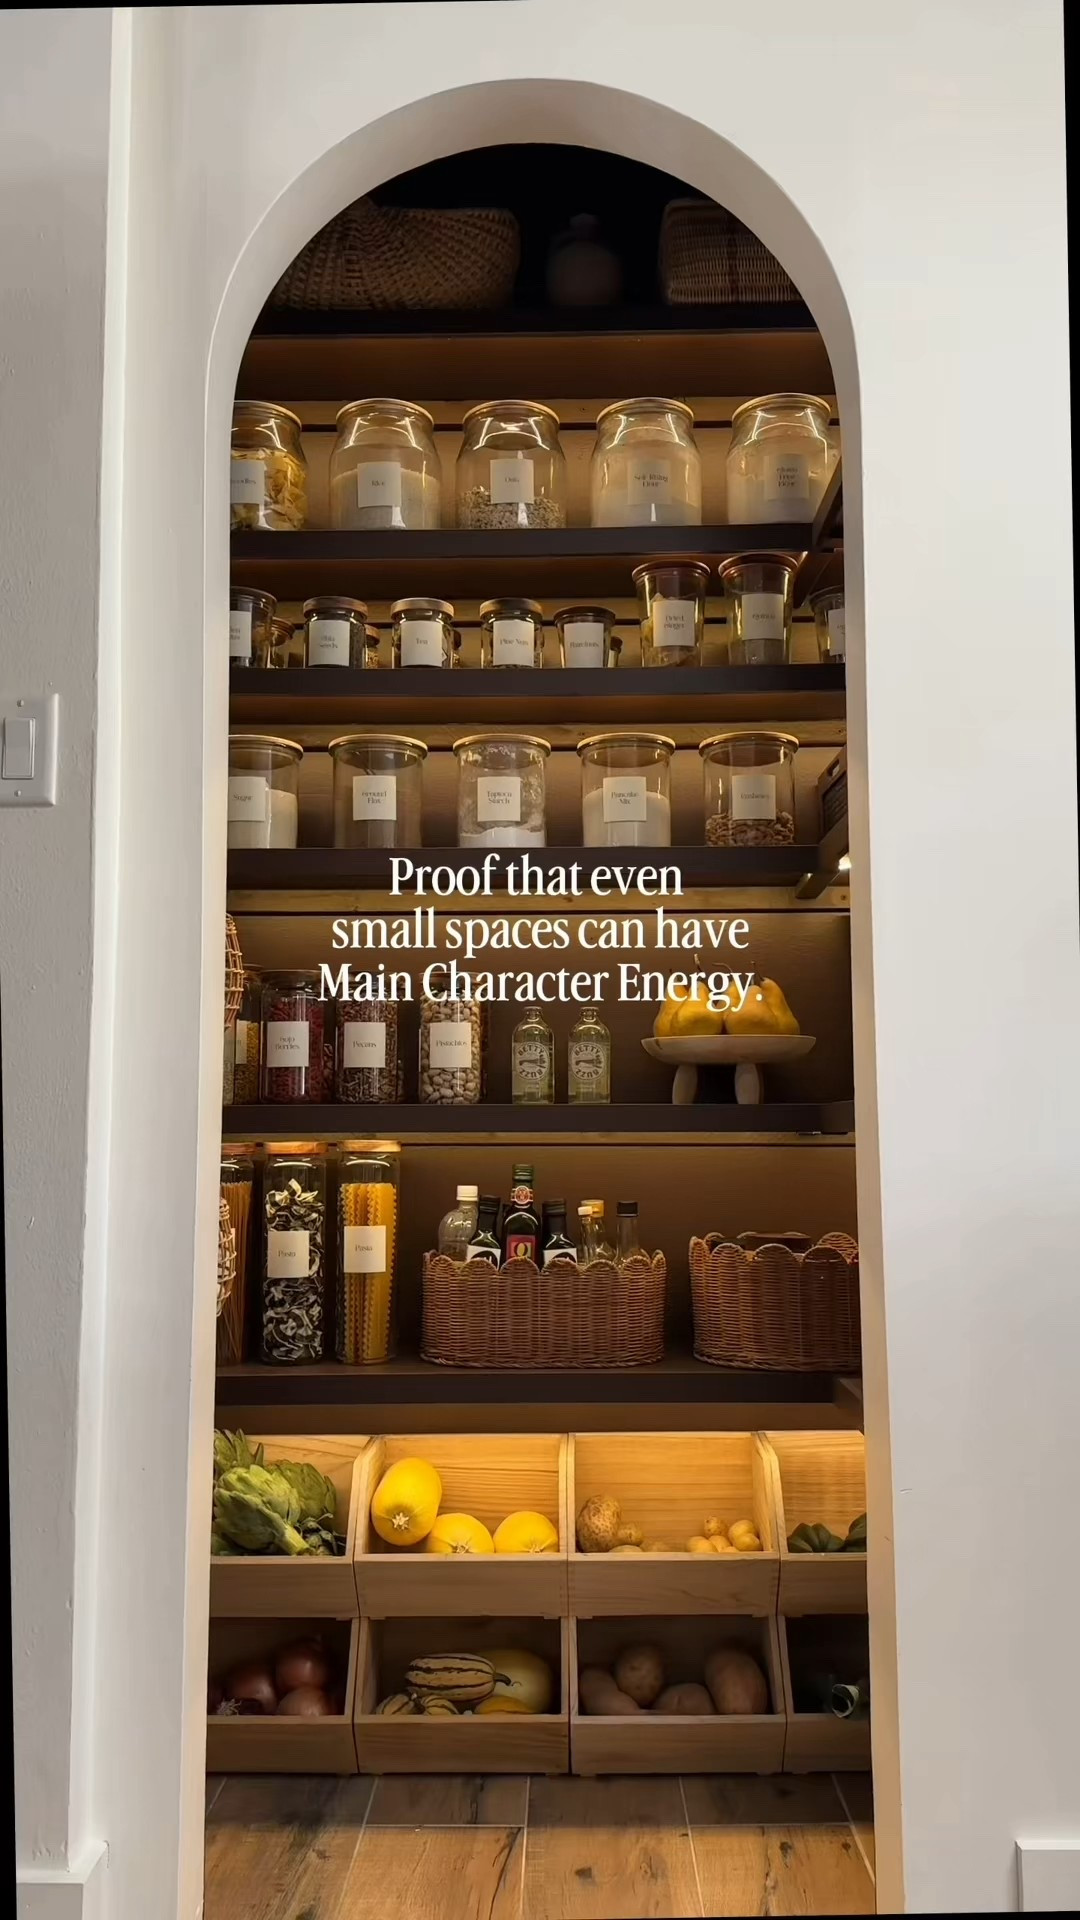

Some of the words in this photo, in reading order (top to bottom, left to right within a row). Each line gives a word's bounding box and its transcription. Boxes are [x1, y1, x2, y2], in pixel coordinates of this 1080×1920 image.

[415, 637, 429, 645] Tea
[352, 1040, 377, 1048] Pecans
[517, 1044, 545, 1057] BETTY
[574, 1044, 601, 1057] BETTY
[355, 1244, 373, 1252] Pasta
